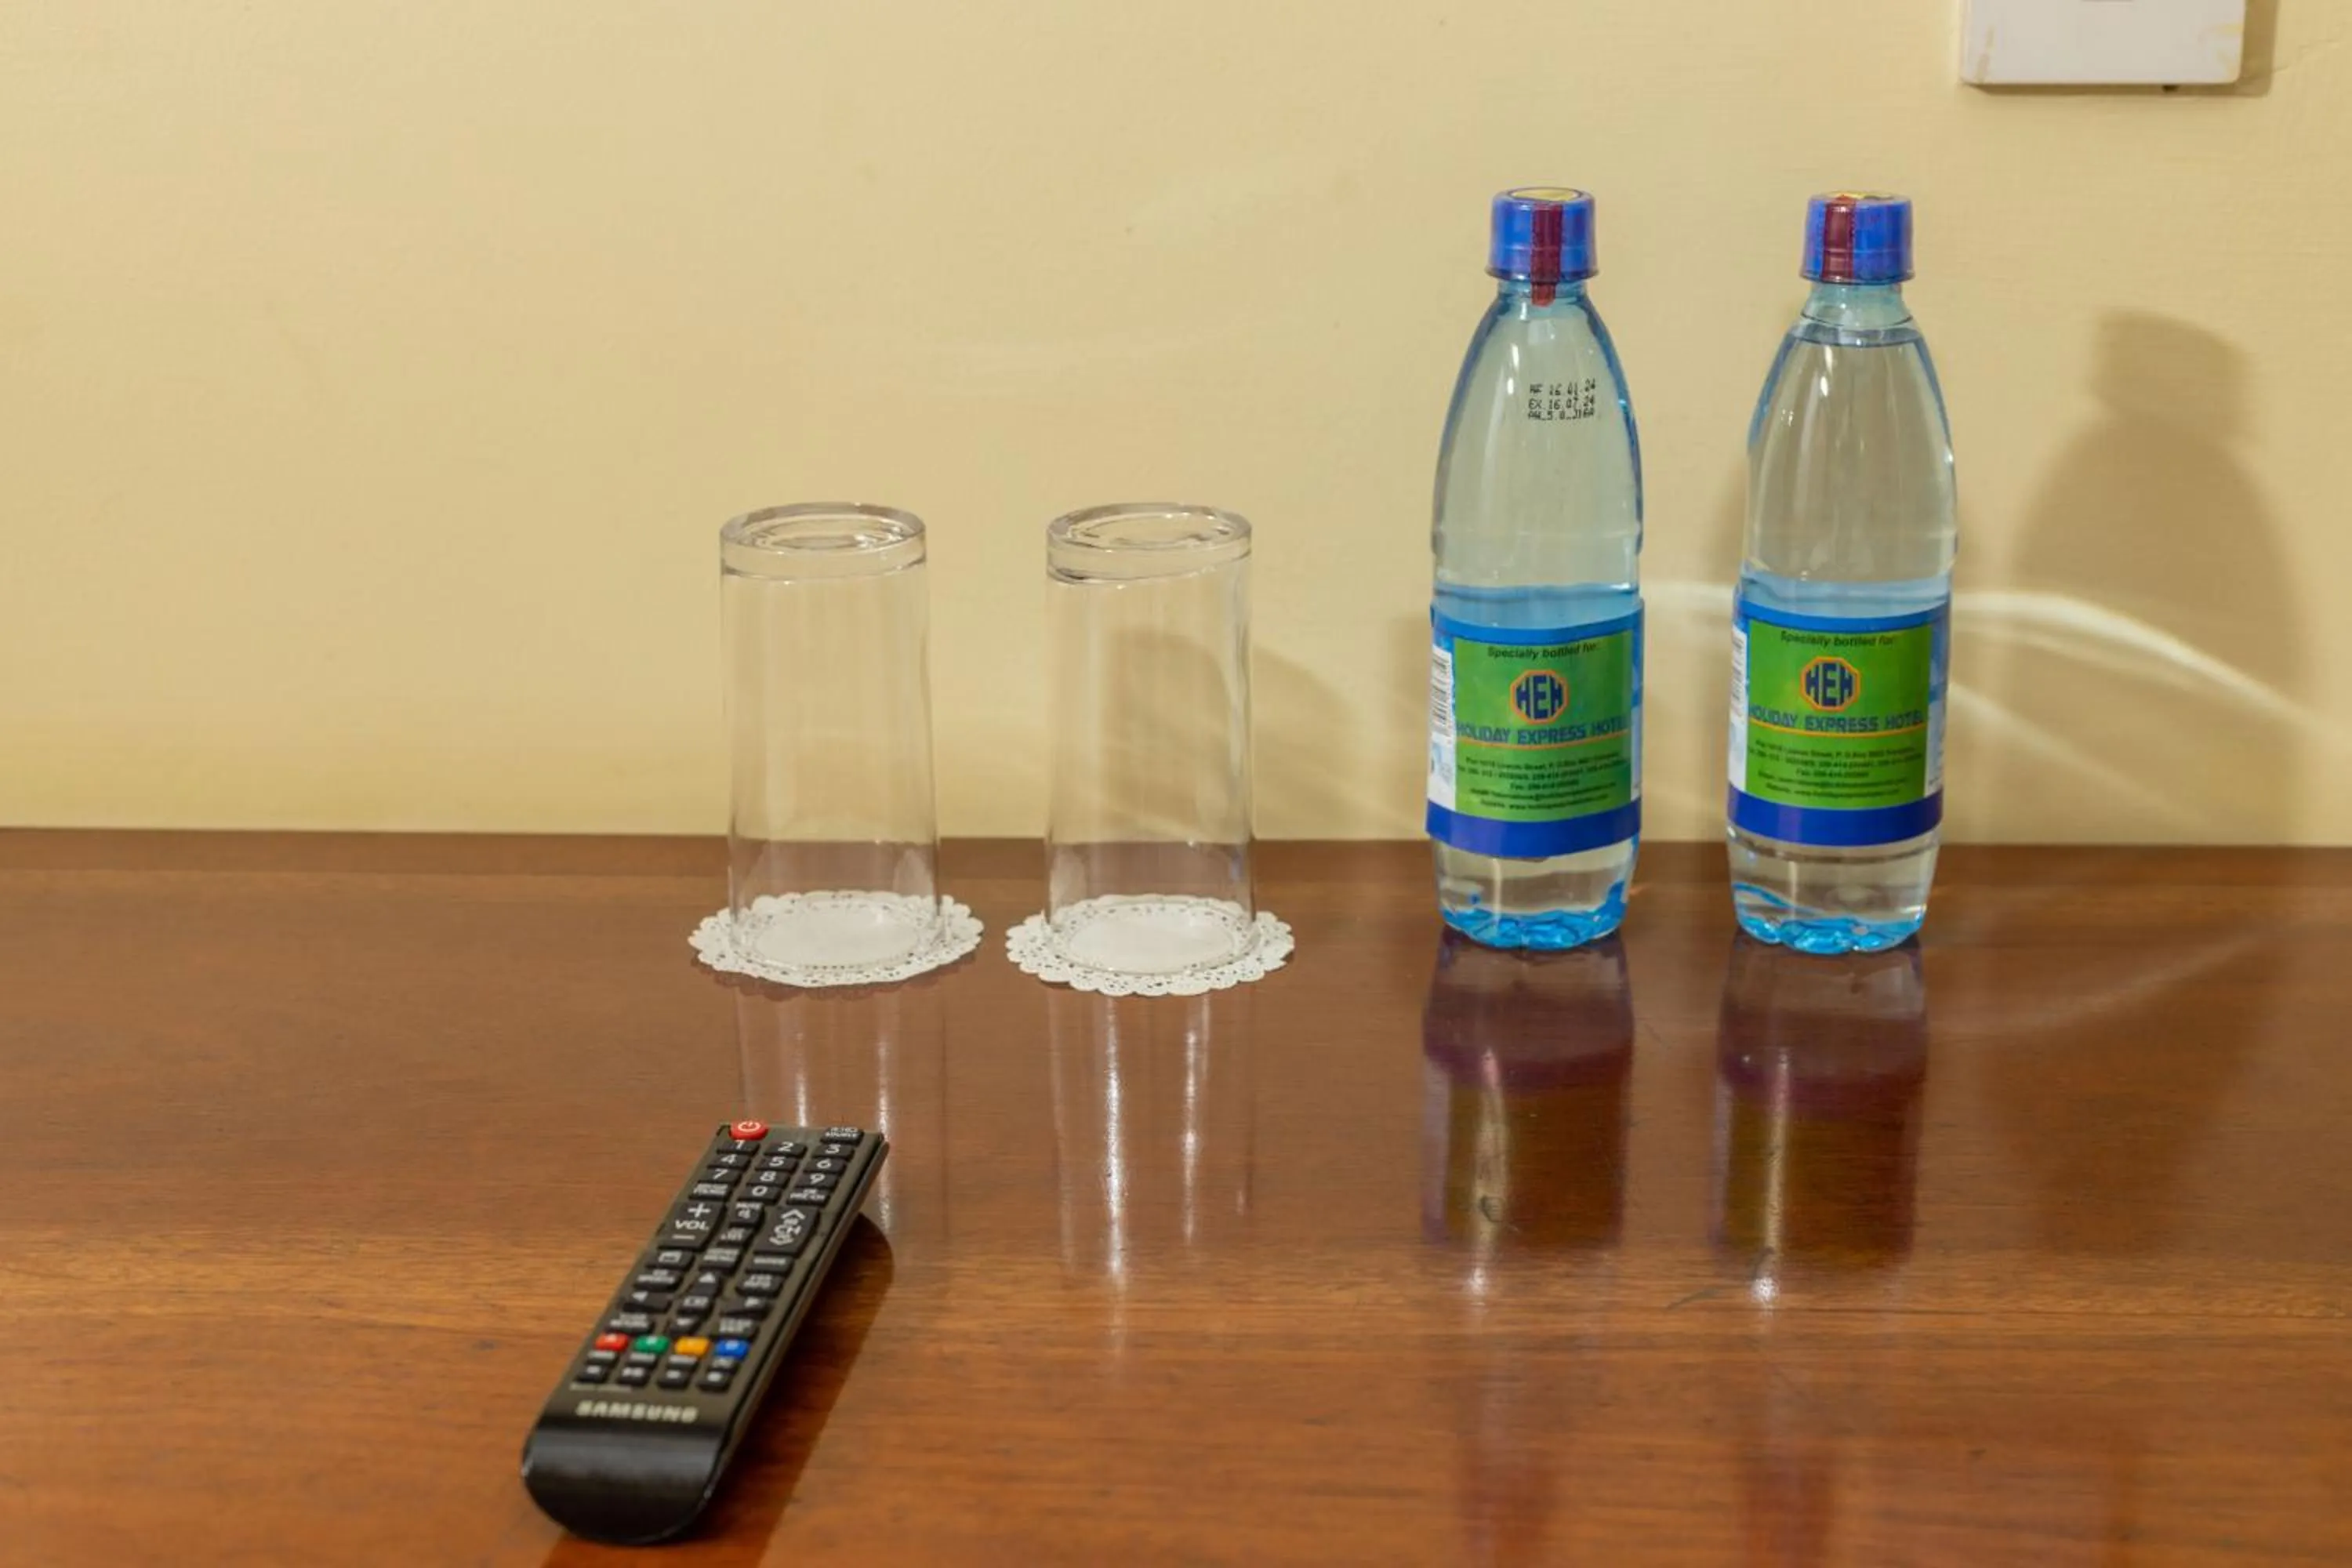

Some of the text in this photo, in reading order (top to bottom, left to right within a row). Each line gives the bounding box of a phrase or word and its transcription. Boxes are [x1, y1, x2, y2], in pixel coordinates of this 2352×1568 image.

[1805, 715, 1879, 733] EXPRESS
[1517, 724, 1586, 745] EXPRESS
[735, 1140, 840, 1154] 1 2 3
[721, 1154, 831, 1170] 4 5 6
[713, 1169, 826, 1184] 7 8 9
[752, 1186, 768, 1196] 0
[674, 1219, 710, 1230] VOL
[773, 1225, 802, 1235] CH
[575, 1400, 699, 1423] SAMSUNG
